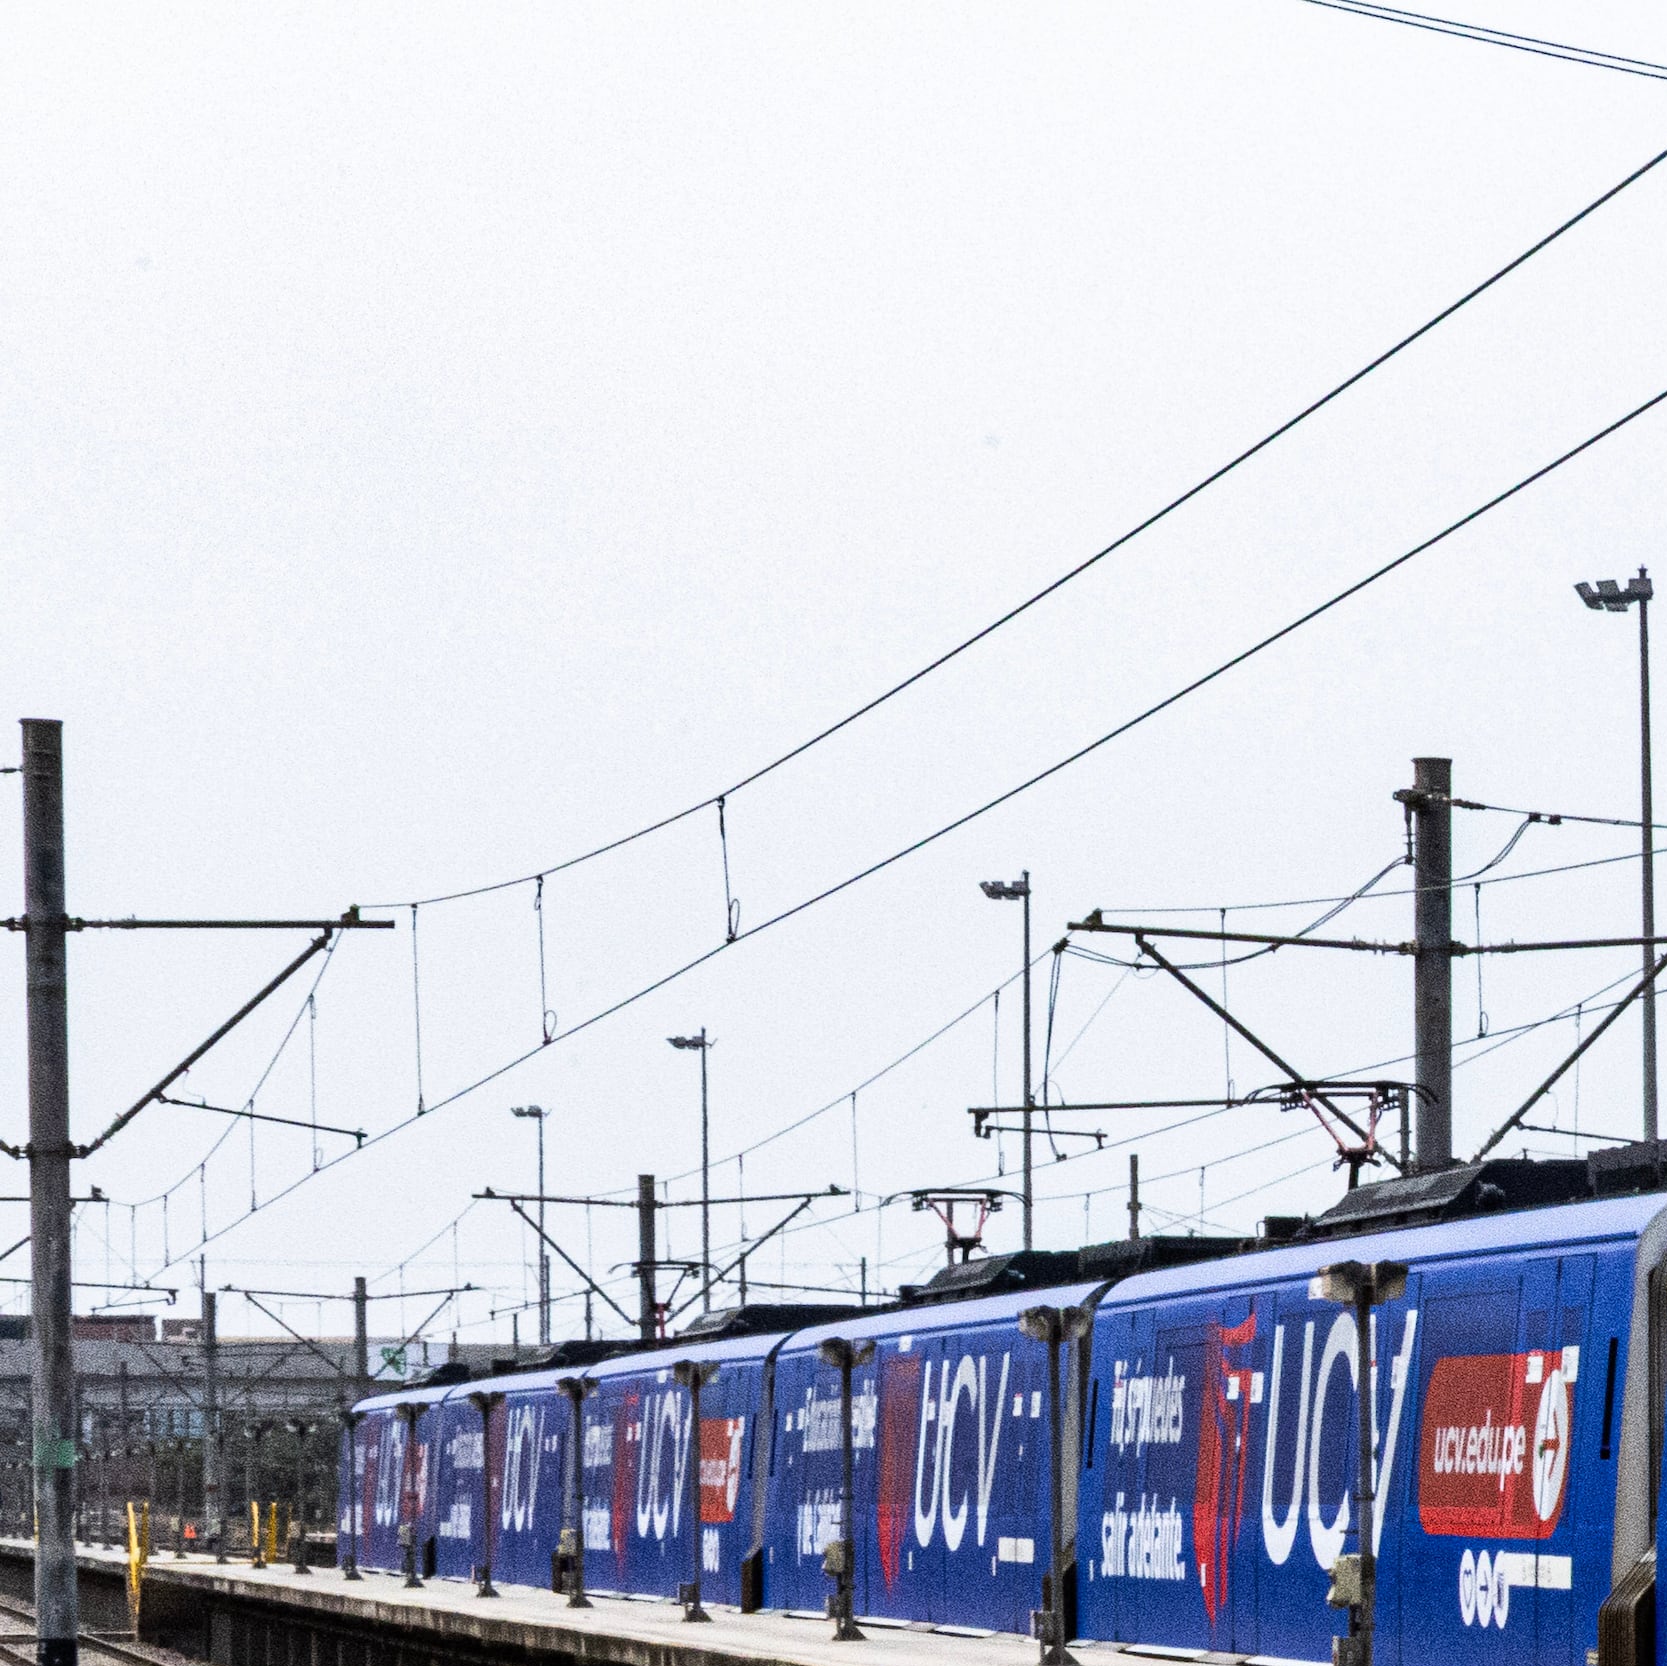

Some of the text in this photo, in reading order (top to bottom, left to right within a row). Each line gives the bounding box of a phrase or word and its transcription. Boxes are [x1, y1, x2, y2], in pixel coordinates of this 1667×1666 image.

[914, 1350, 1009, 1551] UCV
[1262, 1309, 1418, 1570] UCV
[1434, 1408, 1526, 1492] ucv.edu.pe
